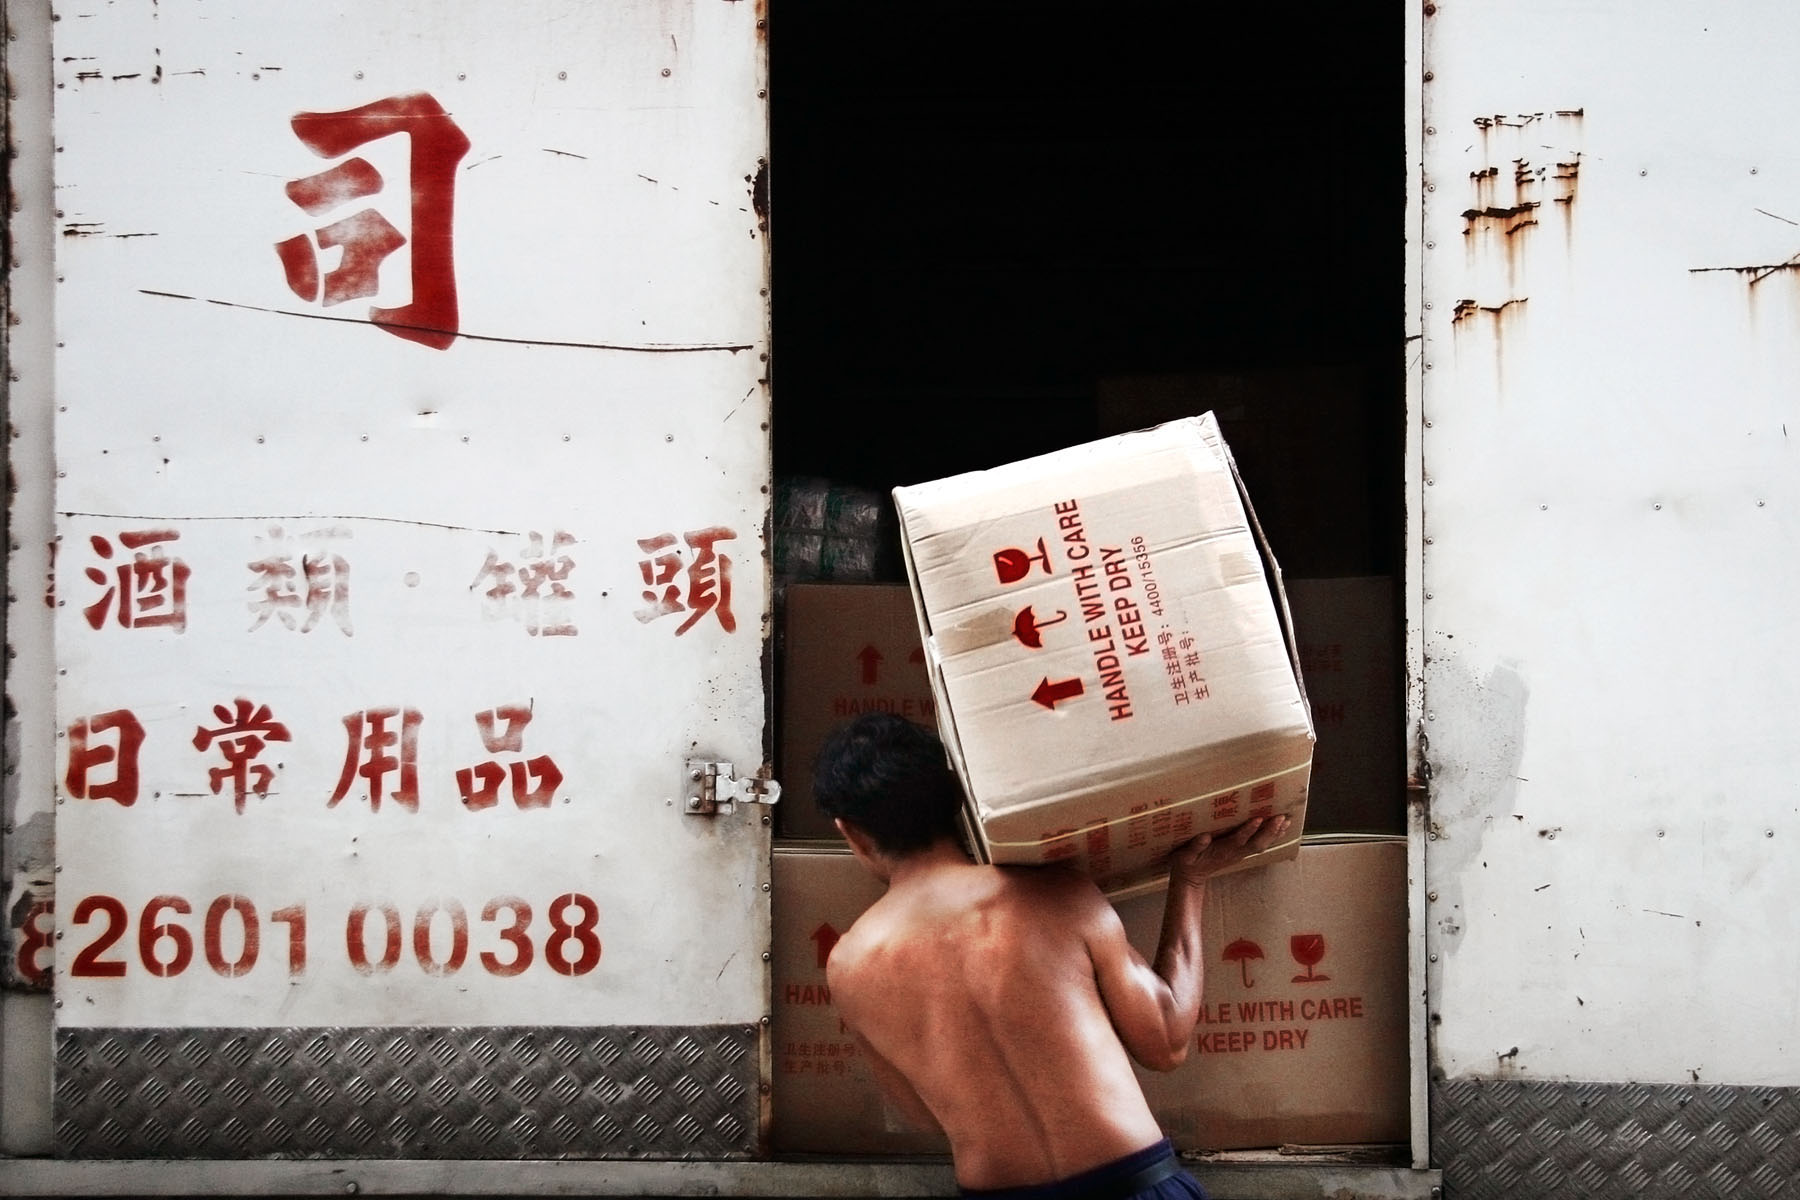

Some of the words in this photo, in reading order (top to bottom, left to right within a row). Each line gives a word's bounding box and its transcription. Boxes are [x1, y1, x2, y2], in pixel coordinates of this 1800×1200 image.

[273, 90, 472, 351] 司
[1055, 499, 1091, 561] CARE
[1072, 564, 1107, 623] WITH
[1099, 548, 1132, 593] DRY
[1130, 535, 1164, 617] 4400/15356
[1114, 597, 1150, 657] KEEP
[1088, 624, 1133, 721] HANDLE
[834, 697, 913, 717] HANDLE
[64, 698, 564, 815] 日常用品
[71, 894, 307, 978] 2601
[346, 892, 602, 977] 0038
[785, 984, 831, 1006] HAN
[1237, 1000, 1295, 1023] WITH
[1300, 997, 1363, 1021] CARE
[1197, 1031, 1257, 1053] KEEP
[1263, 1029, 1309, 1051] DRY
